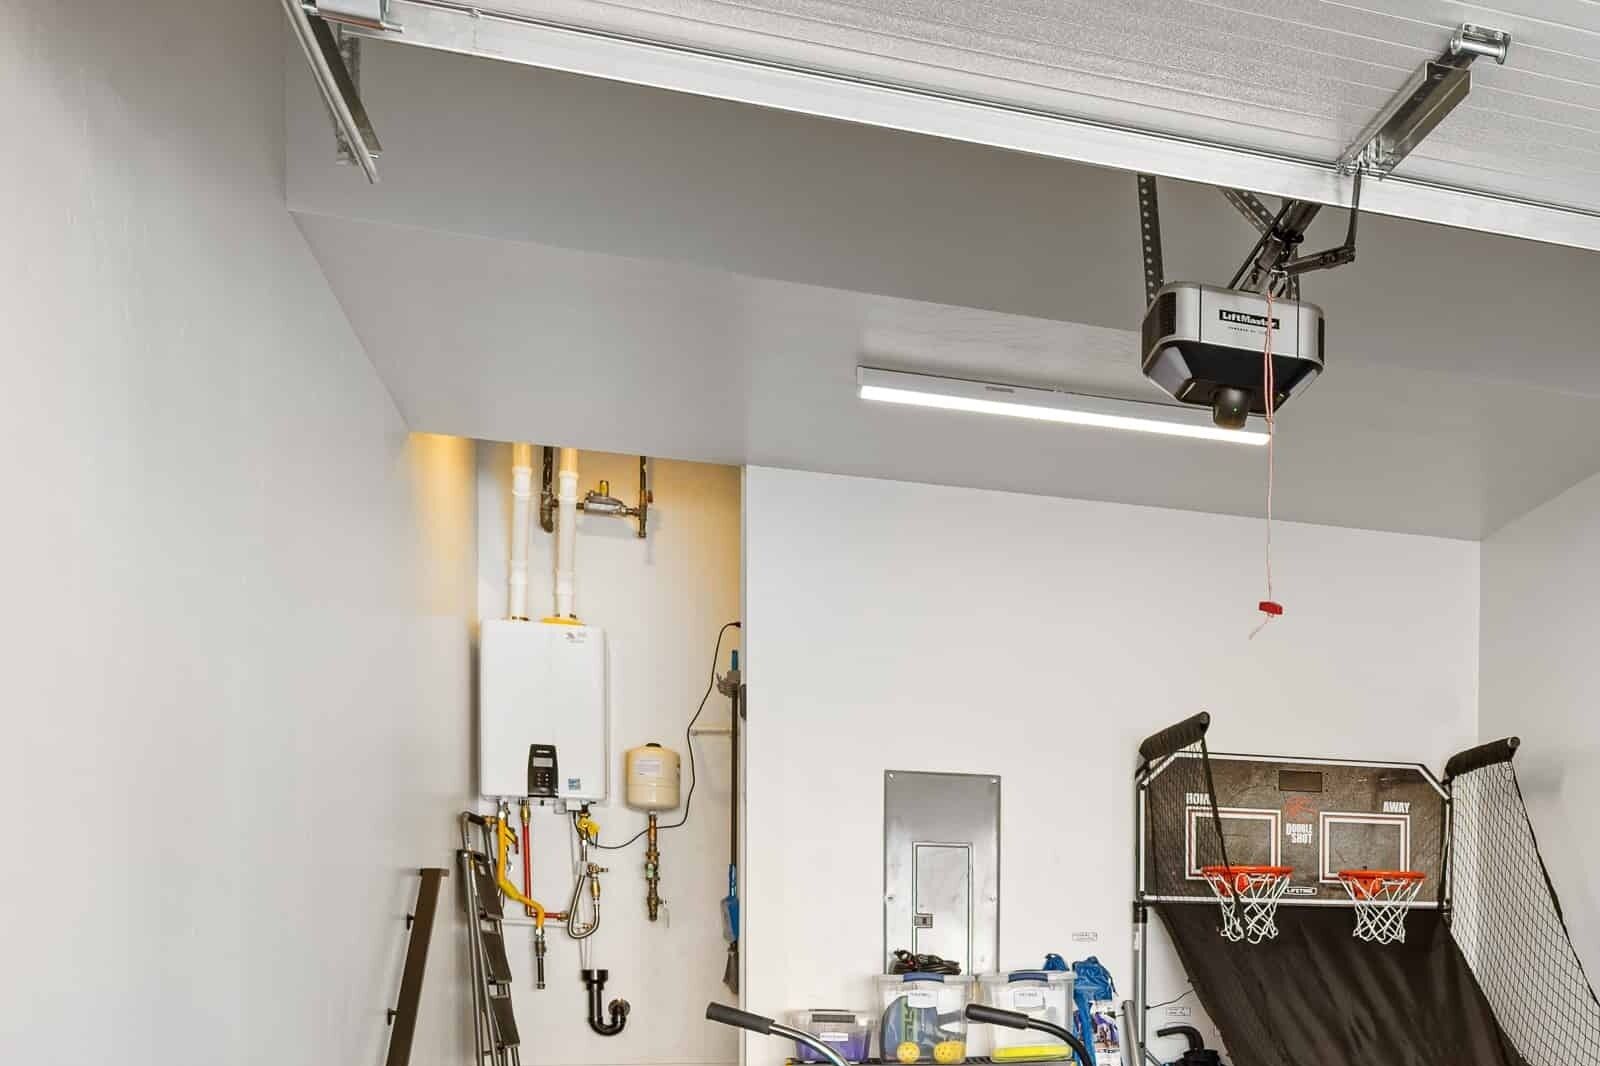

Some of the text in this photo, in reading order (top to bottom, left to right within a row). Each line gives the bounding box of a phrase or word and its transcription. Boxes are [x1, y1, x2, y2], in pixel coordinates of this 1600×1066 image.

[1222, 311, 1277, 328] LiftMastr
[1186, 792, 1211, 805] HOM
[1383, 801, 1410, 813] AWAY
[1286, 824, 1312, 835] DOUBLE
[1291, 833, 1312, 844] SHOT
